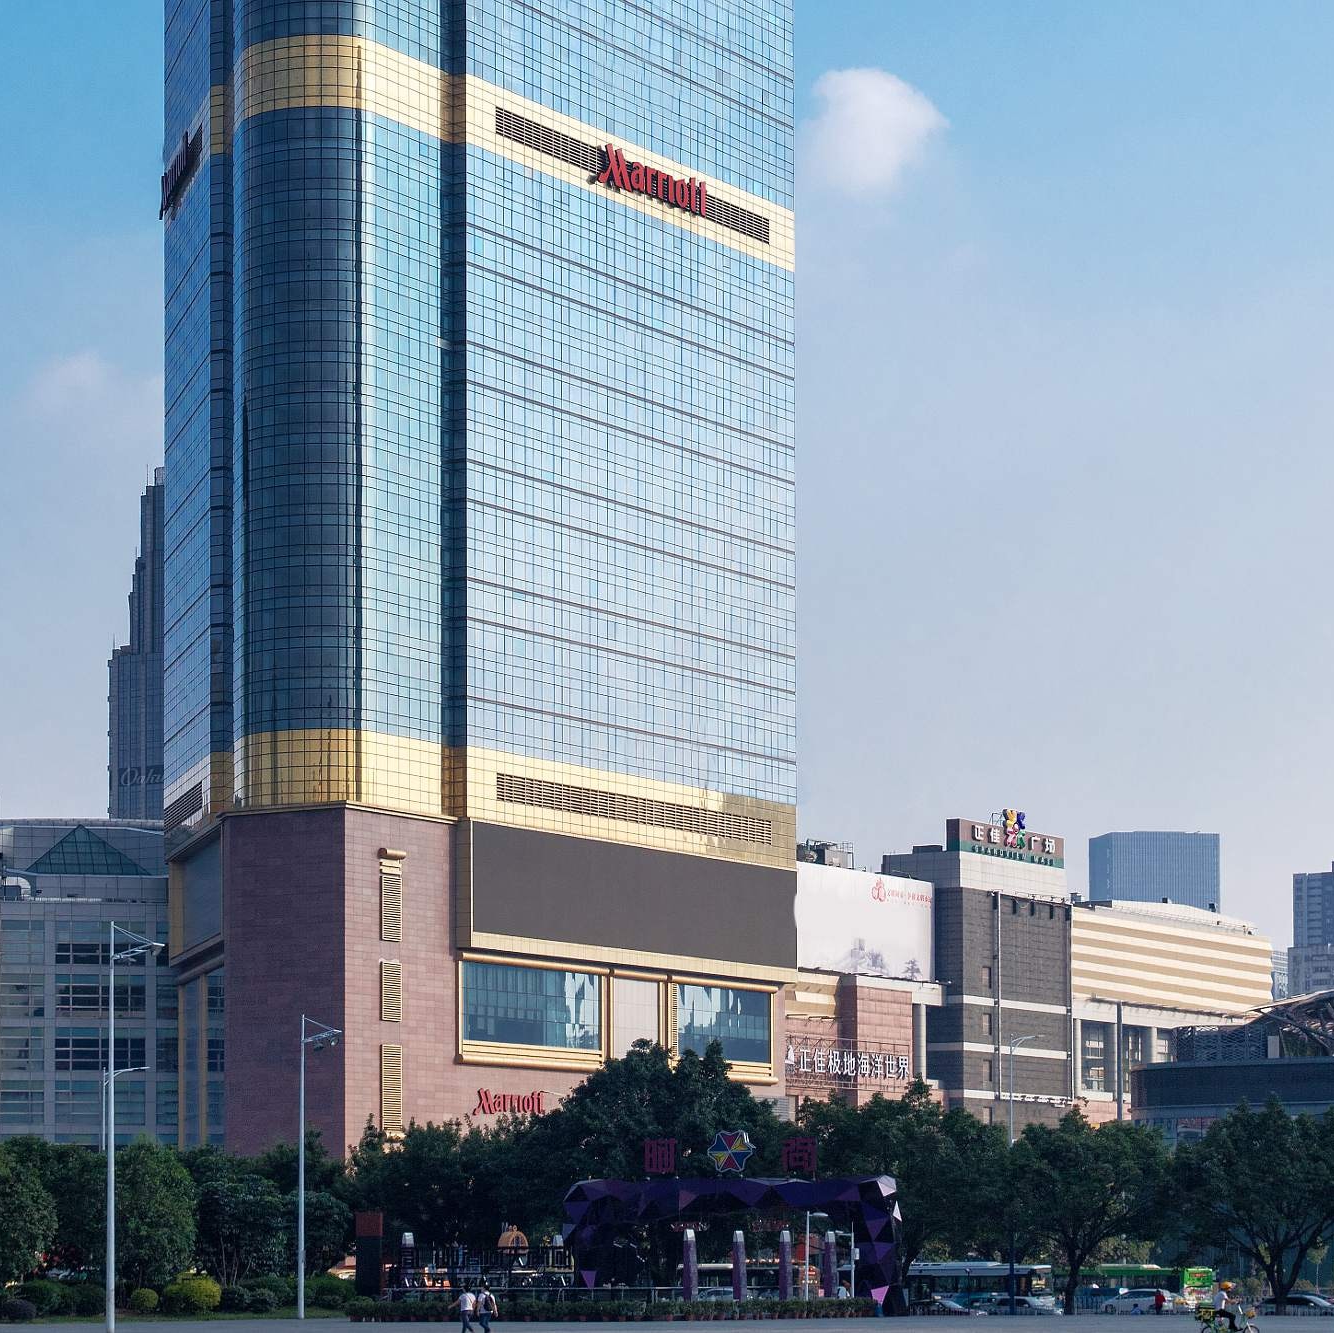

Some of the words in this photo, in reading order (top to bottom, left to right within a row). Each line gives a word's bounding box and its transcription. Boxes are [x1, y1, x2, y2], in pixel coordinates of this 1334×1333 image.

[597, 143, 707, 218] Marriott
[972, 824, 1002, 844] 正佳
[799, 1048, 909, 1079] 正佳极地海洋世界
[472, 1087, 545, 1116] Marriott
